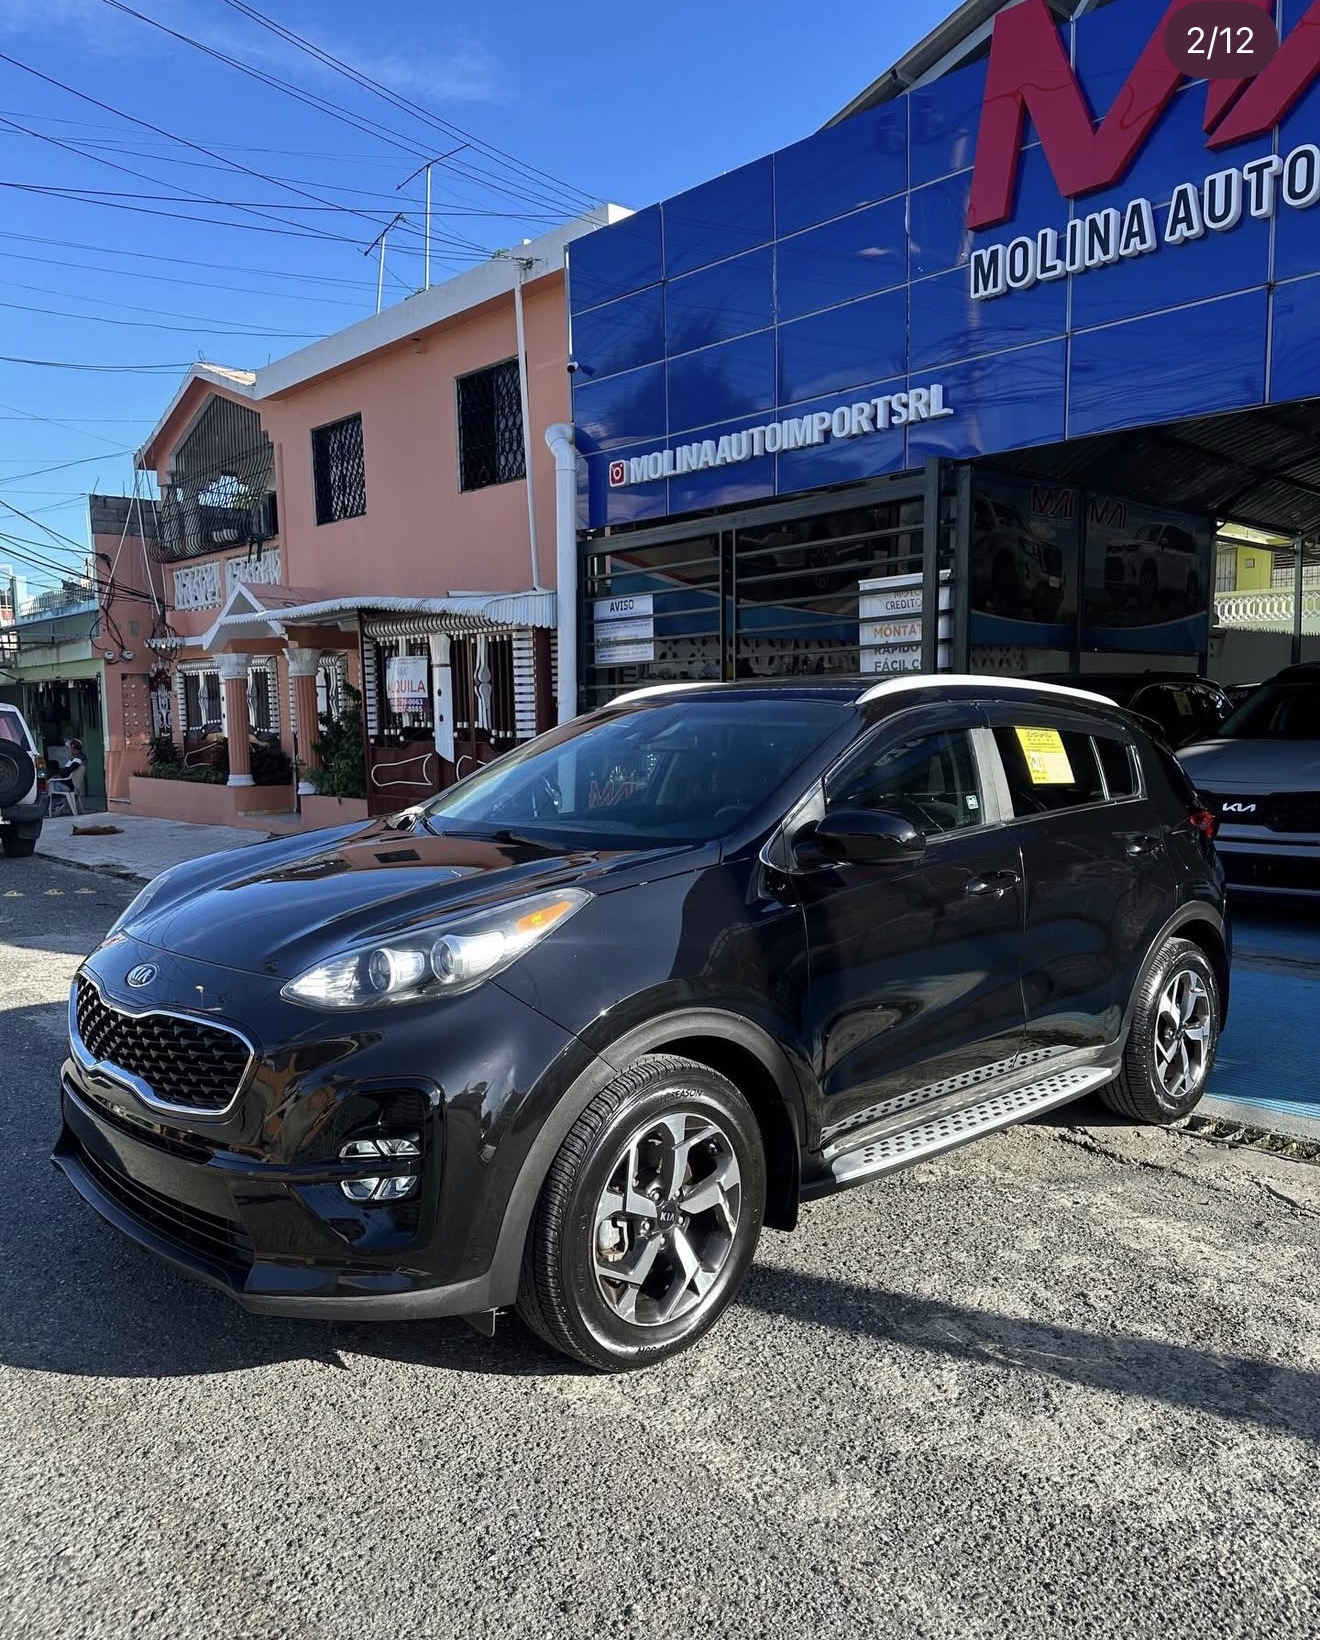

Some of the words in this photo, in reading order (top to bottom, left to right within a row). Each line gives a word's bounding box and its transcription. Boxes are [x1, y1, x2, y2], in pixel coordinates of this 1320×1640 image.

[970, 198, 1156, 300] MOLINA
[1164, 143, 1320, 245] AUTO
[630, 383, 954, 484] MOLINAAUTOIMPORTSRL
[609, 599, 635, 613] AVISO
[671, 1088, 704, 1099] SEASON
[660, 1211, 675, 1222] KIA
